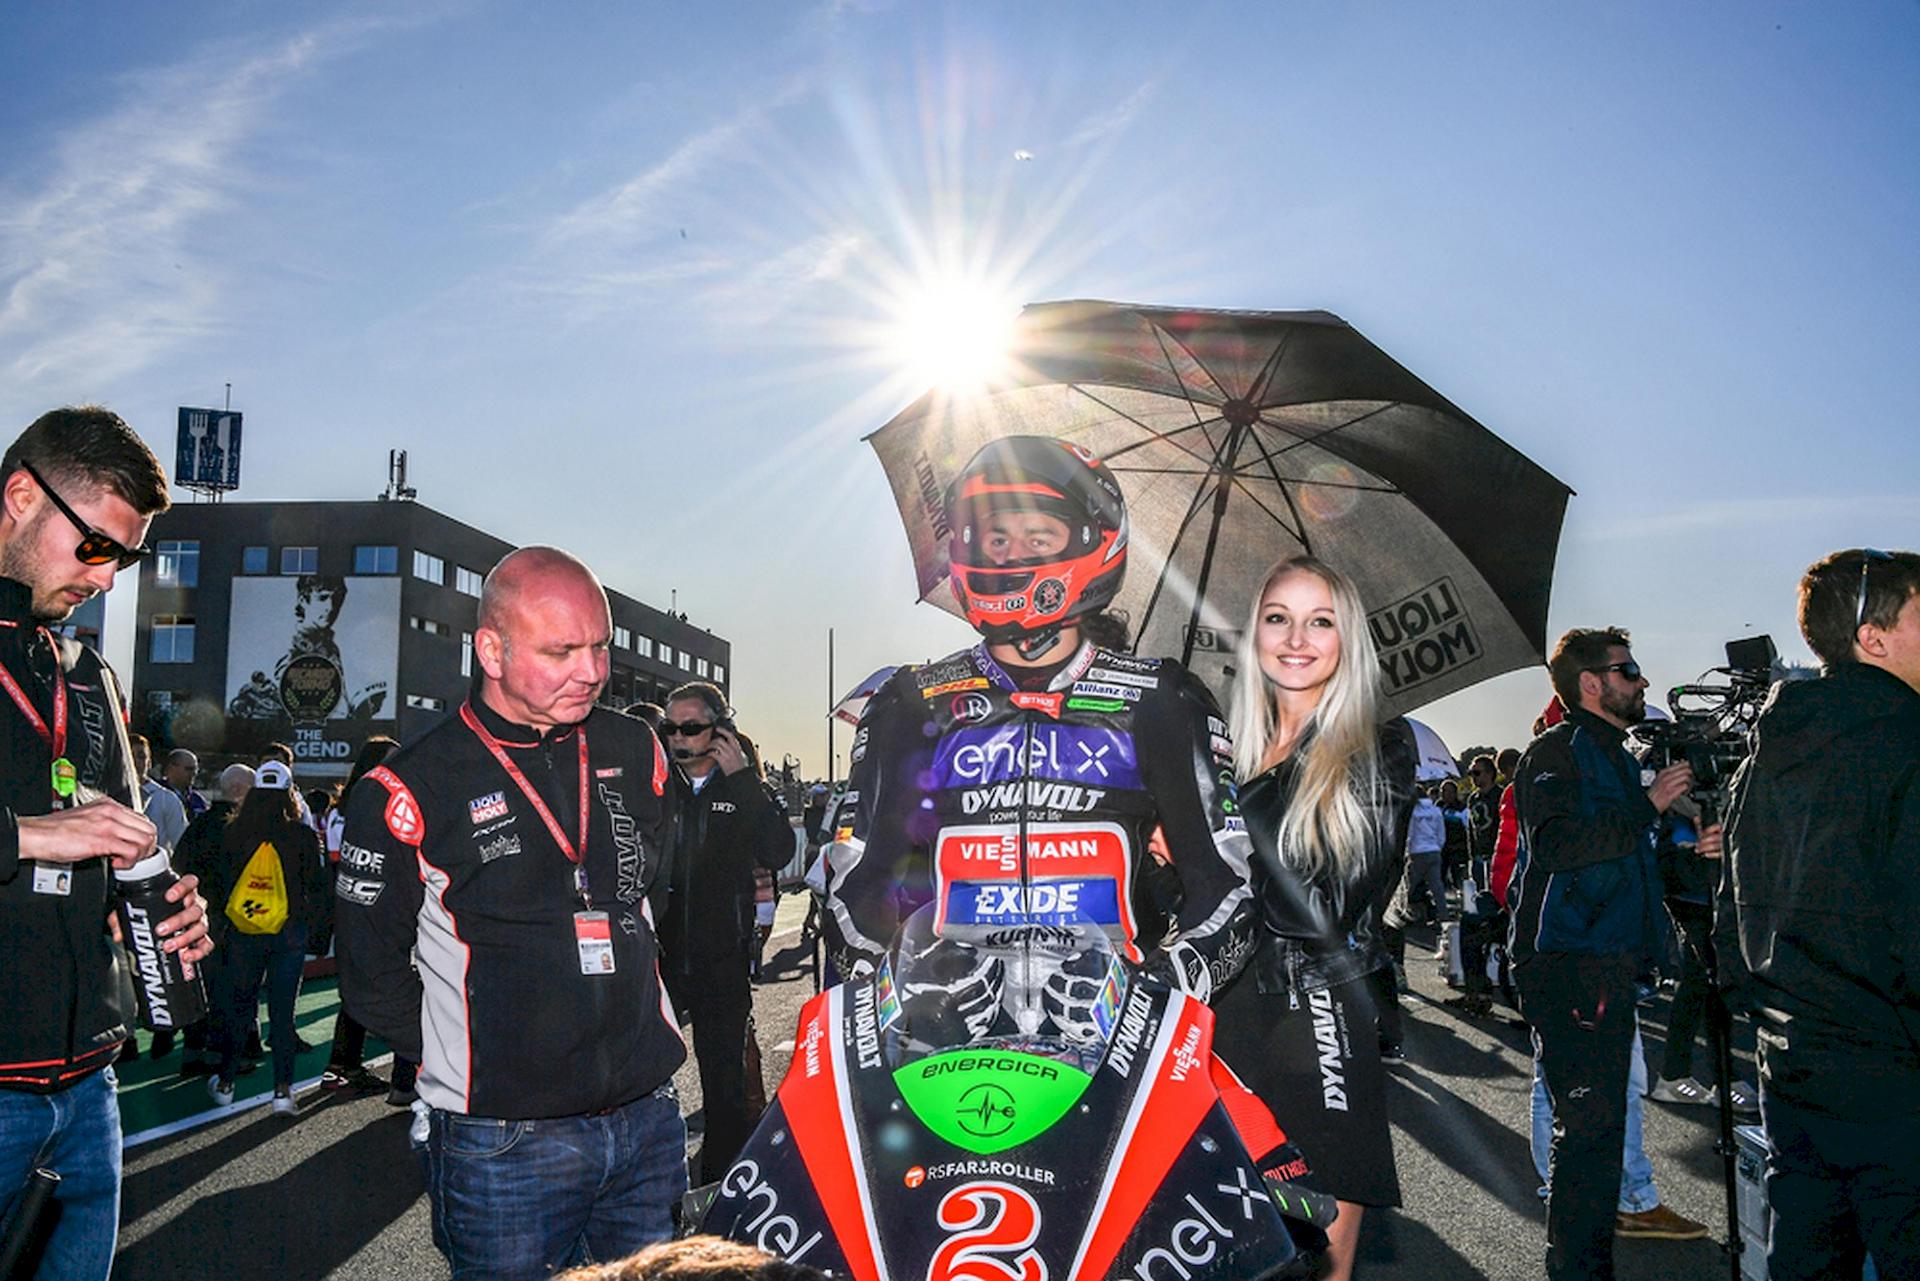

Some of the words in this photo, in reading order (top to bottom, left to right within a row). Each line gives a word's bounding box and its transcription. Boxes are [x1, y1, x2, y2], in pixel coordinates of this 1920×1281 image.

[1097, 652, 1160, 672] DYNAVOLT
[1074, 683, 1121, 696] Allianz
[292, 742, 350, 757] GEND
[295, 729, 322, 741] THE
[953, 731, 1060, 780] enel
[472, 802, 509, 823] MOLY
[962, 781, 1106, 814] DYNAVOLT
[960, 835, 1098, 871] VIESSMANN
[975, 884, 1080, 915] EXIDE
[126, 901, 172, 1027] DYNAVOLT
[800, 1017, 825, 1079] VIESSMANN
[855, 984, 882, 1069] DYNAVOLT
[1108, 984, 1153, 1079] DYNAVOLT
[1170, 1023, 1202, 1083] VIESSMANN
[721, 1159, 823, 1265] enel
[926, 1180, 1049, 1281] 2
[1125, 1193, 1234, 1281] nel
